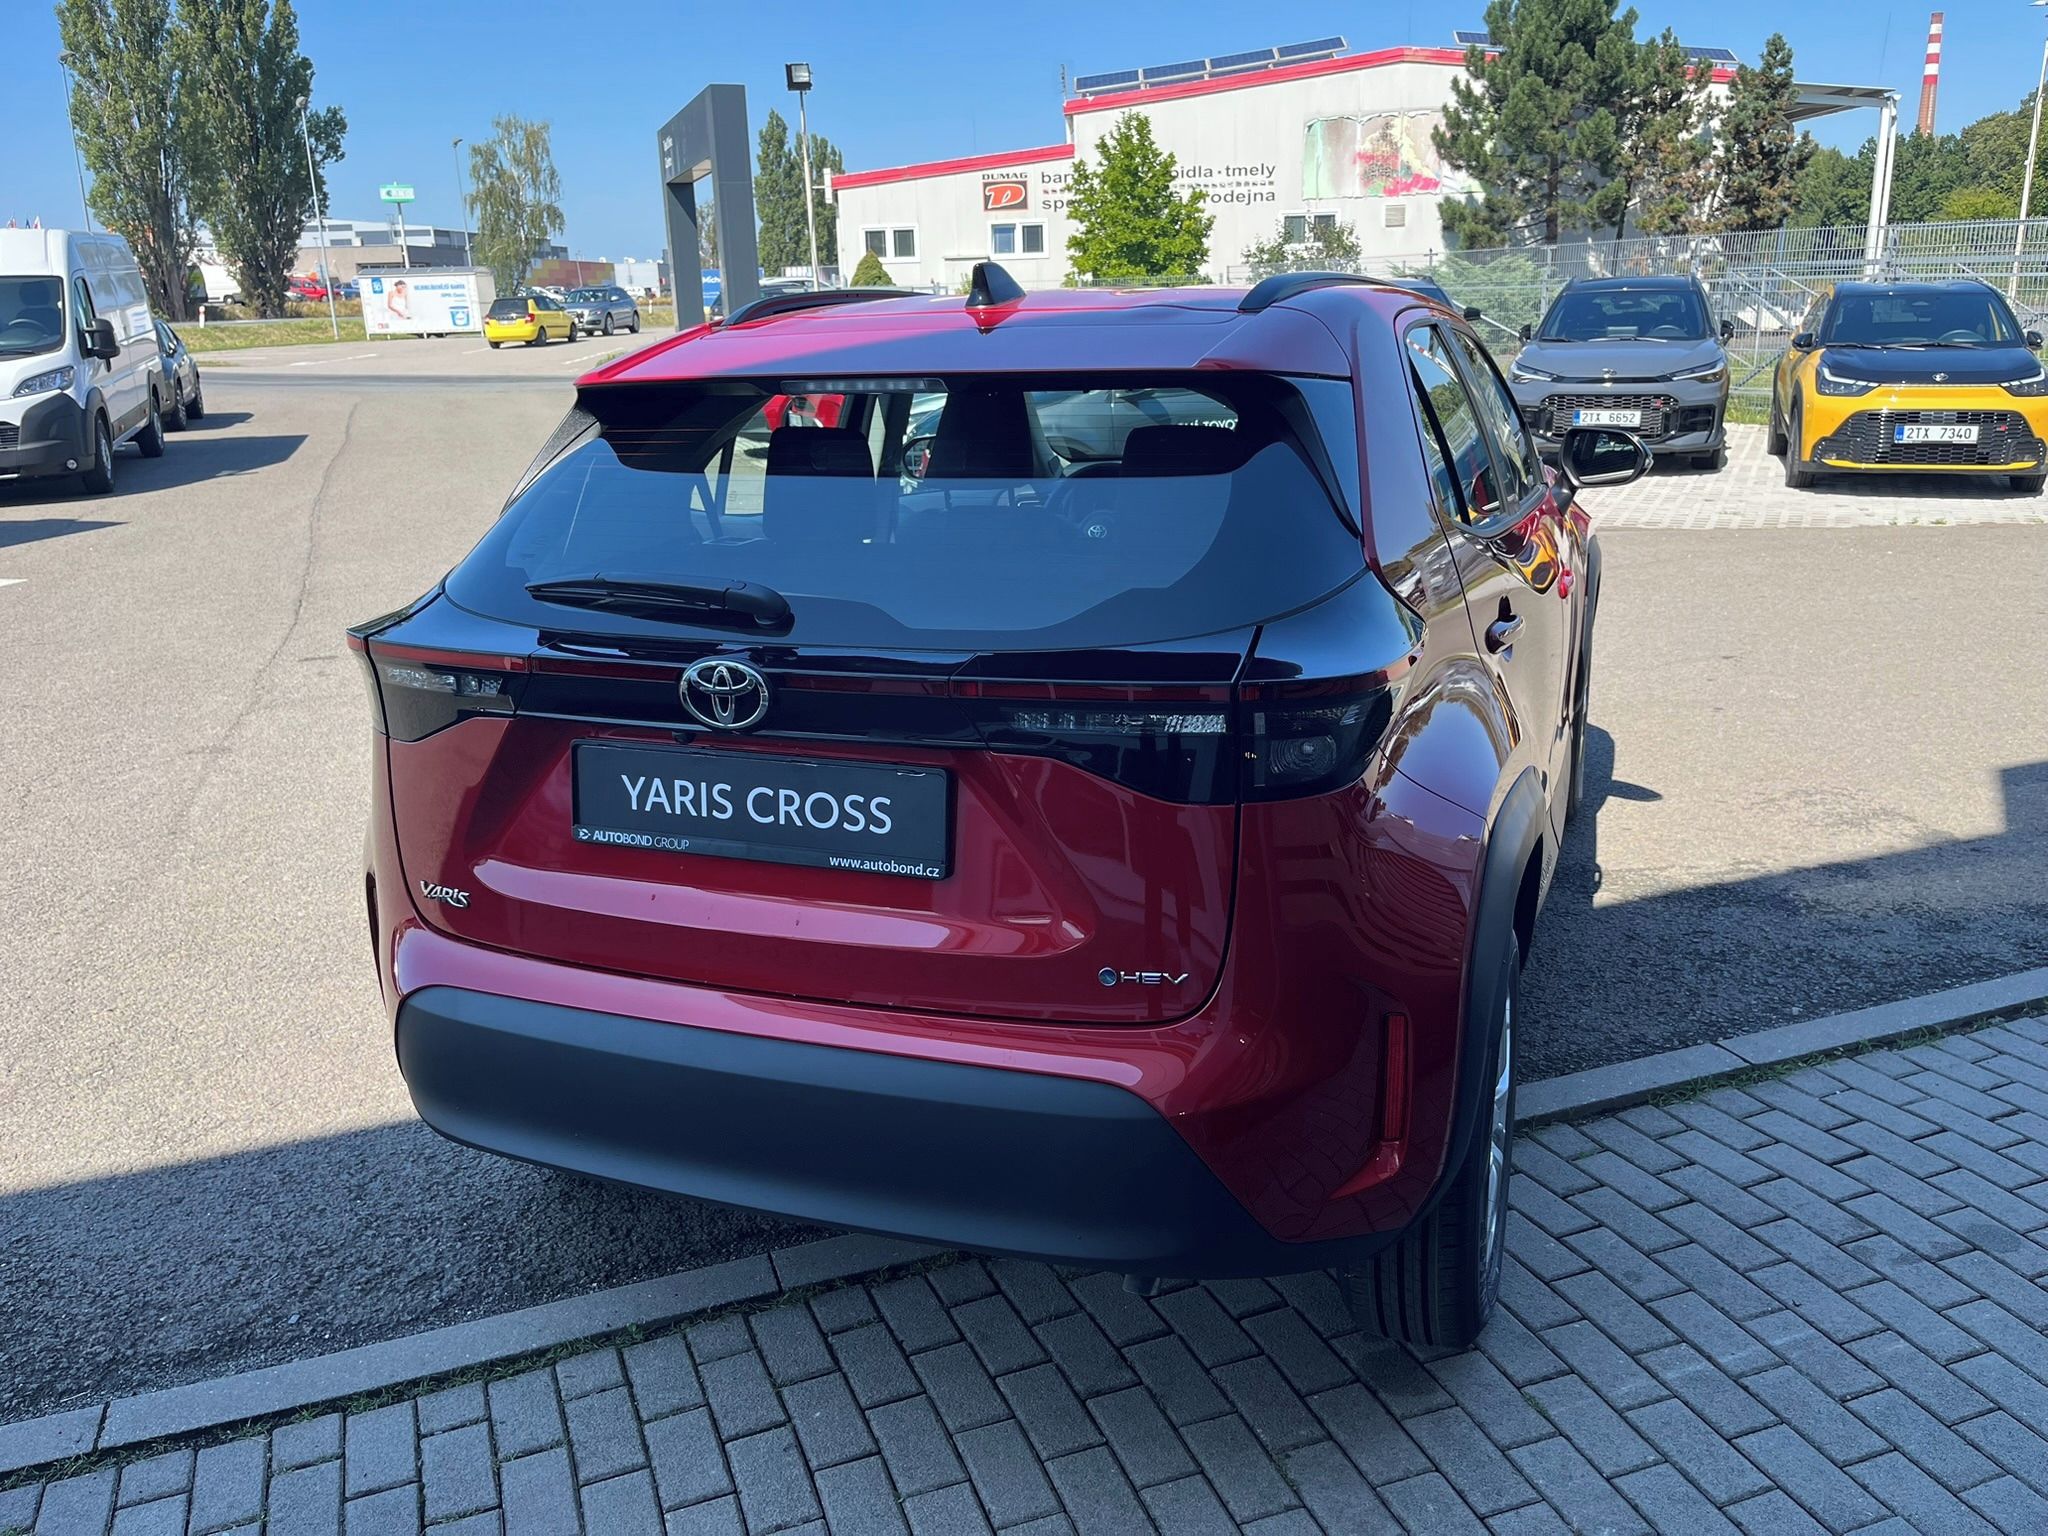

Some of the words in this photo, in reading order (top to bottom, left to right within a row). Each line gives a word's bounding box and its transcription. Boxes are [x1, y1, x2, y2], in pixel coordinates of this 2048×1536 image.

[982, 172, 1028, 181] DUMAG
[1041, 171, 1075, 184] bar
[1225, 163, 1276, 179] tmely
[1582, 412, 1601, 423] 2TX
[1608, 412, 1636, 424] 6652
[1906, 428, 1930, 440] 2TX
[1940, 428, 1972, 440] 7340
[621, 774, 733, 820] YARIS
[746, 786, 892, 835] CROSS
[593, 830, 652, 847] AUTOBOND
[654, 836, 689, 850] GROUP
[829, 856, 940, 877] www.autobond.cz
[1120, 971, 1189, 985] HEV
